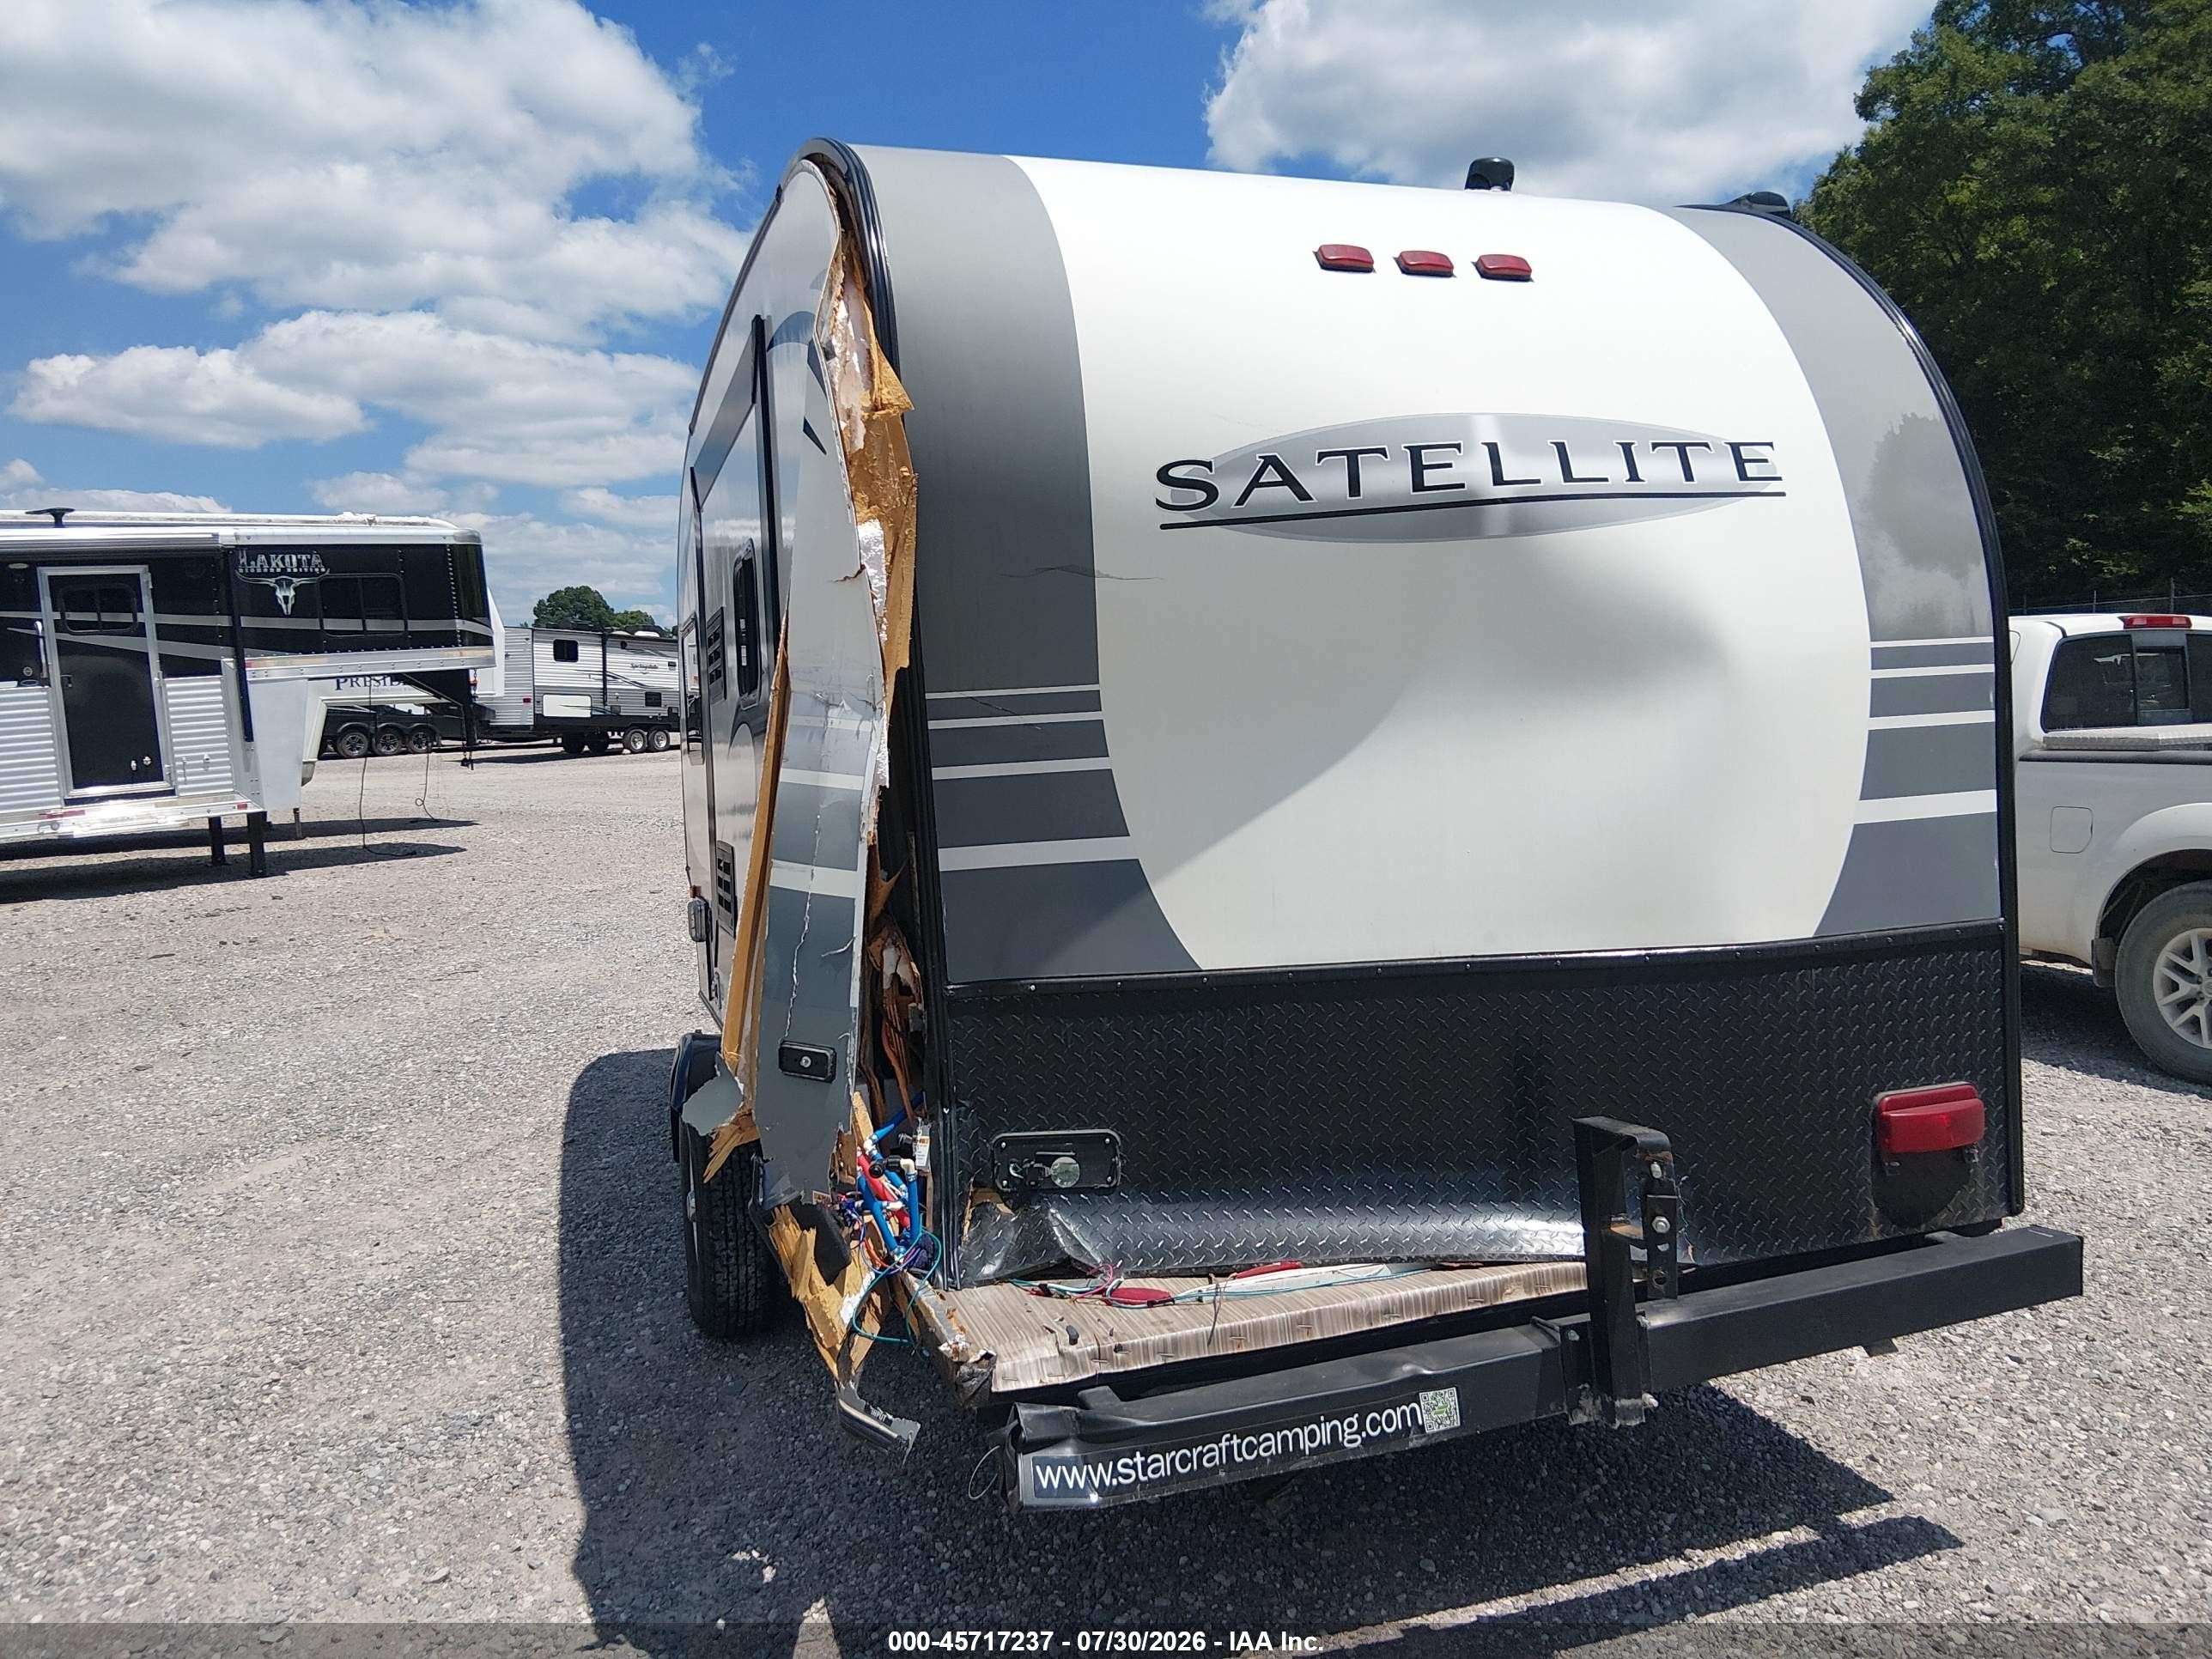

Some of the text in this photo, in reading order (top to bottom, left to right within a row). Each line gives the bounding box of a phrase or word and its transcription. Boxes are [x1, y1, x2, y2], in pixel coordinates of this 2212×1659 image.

[1154, 441, 1784, 513] SATELLITE
[239, 548, 326, 568] LAKOTA
[1036, 1401, 1423, 1489] www.starcraftcamping.com
